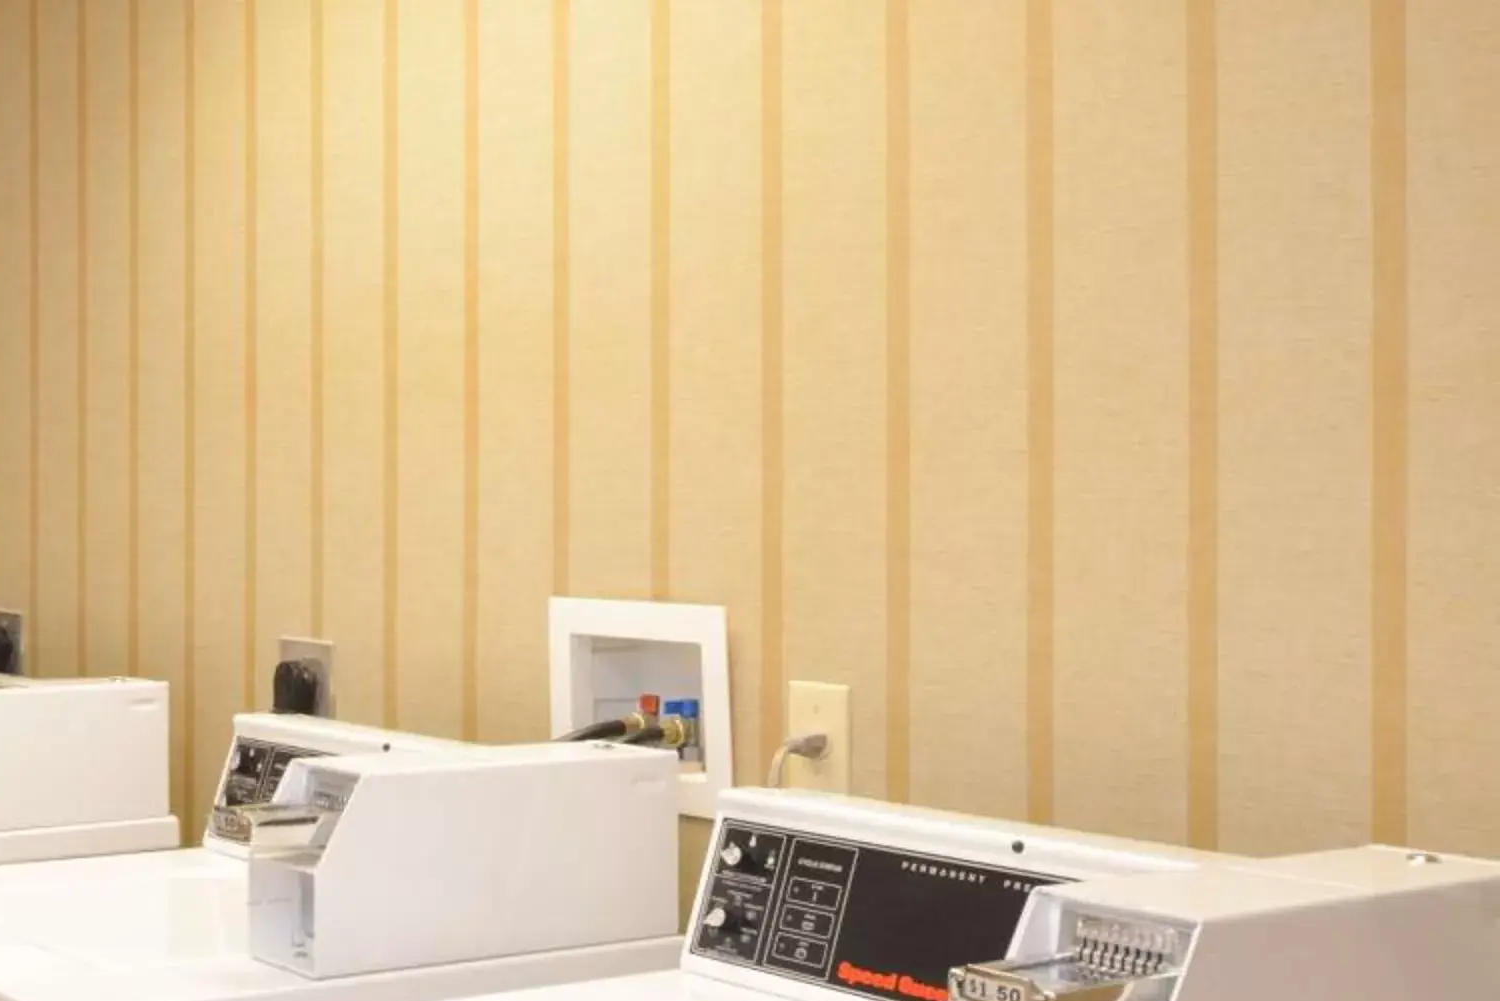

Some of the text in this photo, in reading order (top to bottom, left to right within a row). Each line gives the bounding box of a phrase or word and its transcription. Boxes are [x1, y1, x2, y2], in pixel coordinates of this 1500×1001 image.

[900, 860, 1033, 893] PERMANENT PRE
[837, 960, 898, 992] Speed
